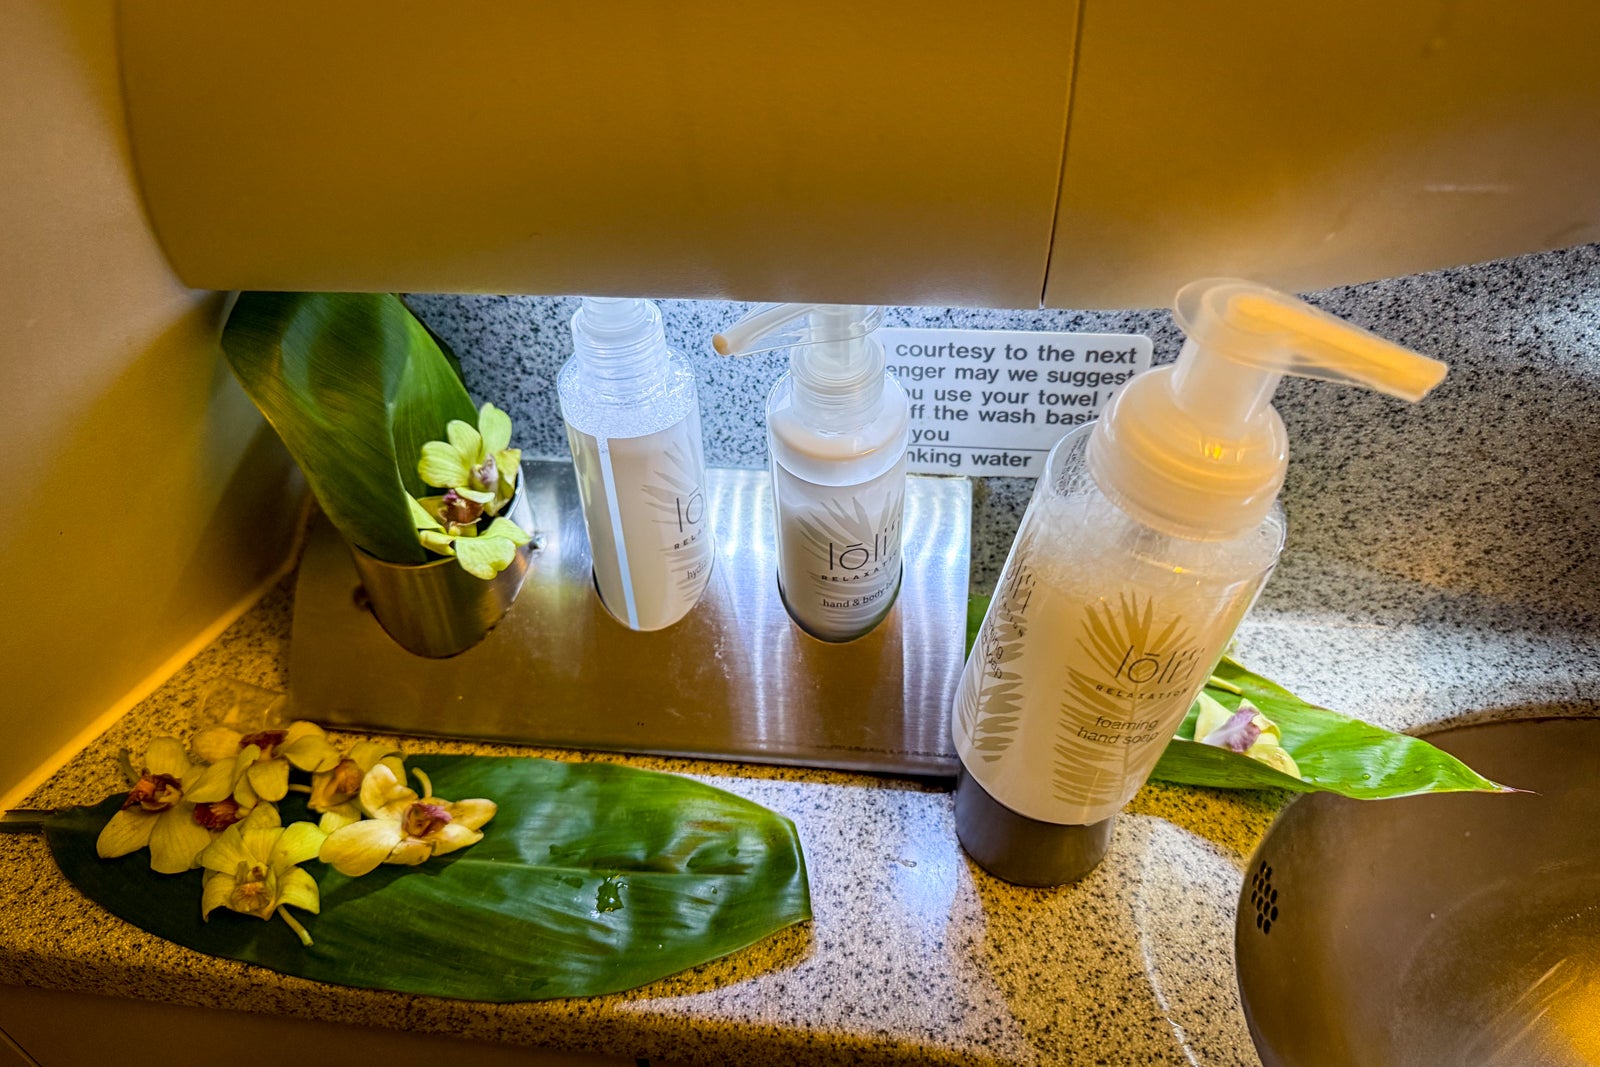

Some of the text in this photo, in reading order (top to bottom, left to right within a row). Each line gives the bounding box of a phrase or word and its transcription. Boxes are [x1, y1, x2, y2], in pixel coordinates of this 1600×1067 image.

[896, 342, 995, 362] courtesy
[1005, 344, 1028, 360] to
[1038, 345, 1075, 362] the
[1085, 347, 1137, 364] next
[885, 364, 946, 381] enger
[955, 366, 999, 384] may
[1008, 370, 1038, 381] we
[934, 388, 972, 402] use
[981, 391, 1030, 406] your
[1038, 390, 1098, 406] towel
[910, 404, 925, 419] ff
[934, 405, 969, 421] the
[978, 408, 1036, 424] wash
[912, 428, 949, 443] you
[907, 448, 1032, 467] nking water
[822, 599, 850, 608] hand
[851, 597, 860, 607] &
[1095, 684, 1190, 700] RELAXATION
[1095, 715, 1159, 731] foaming
[1076, 726, 1160, 745] hand soap
